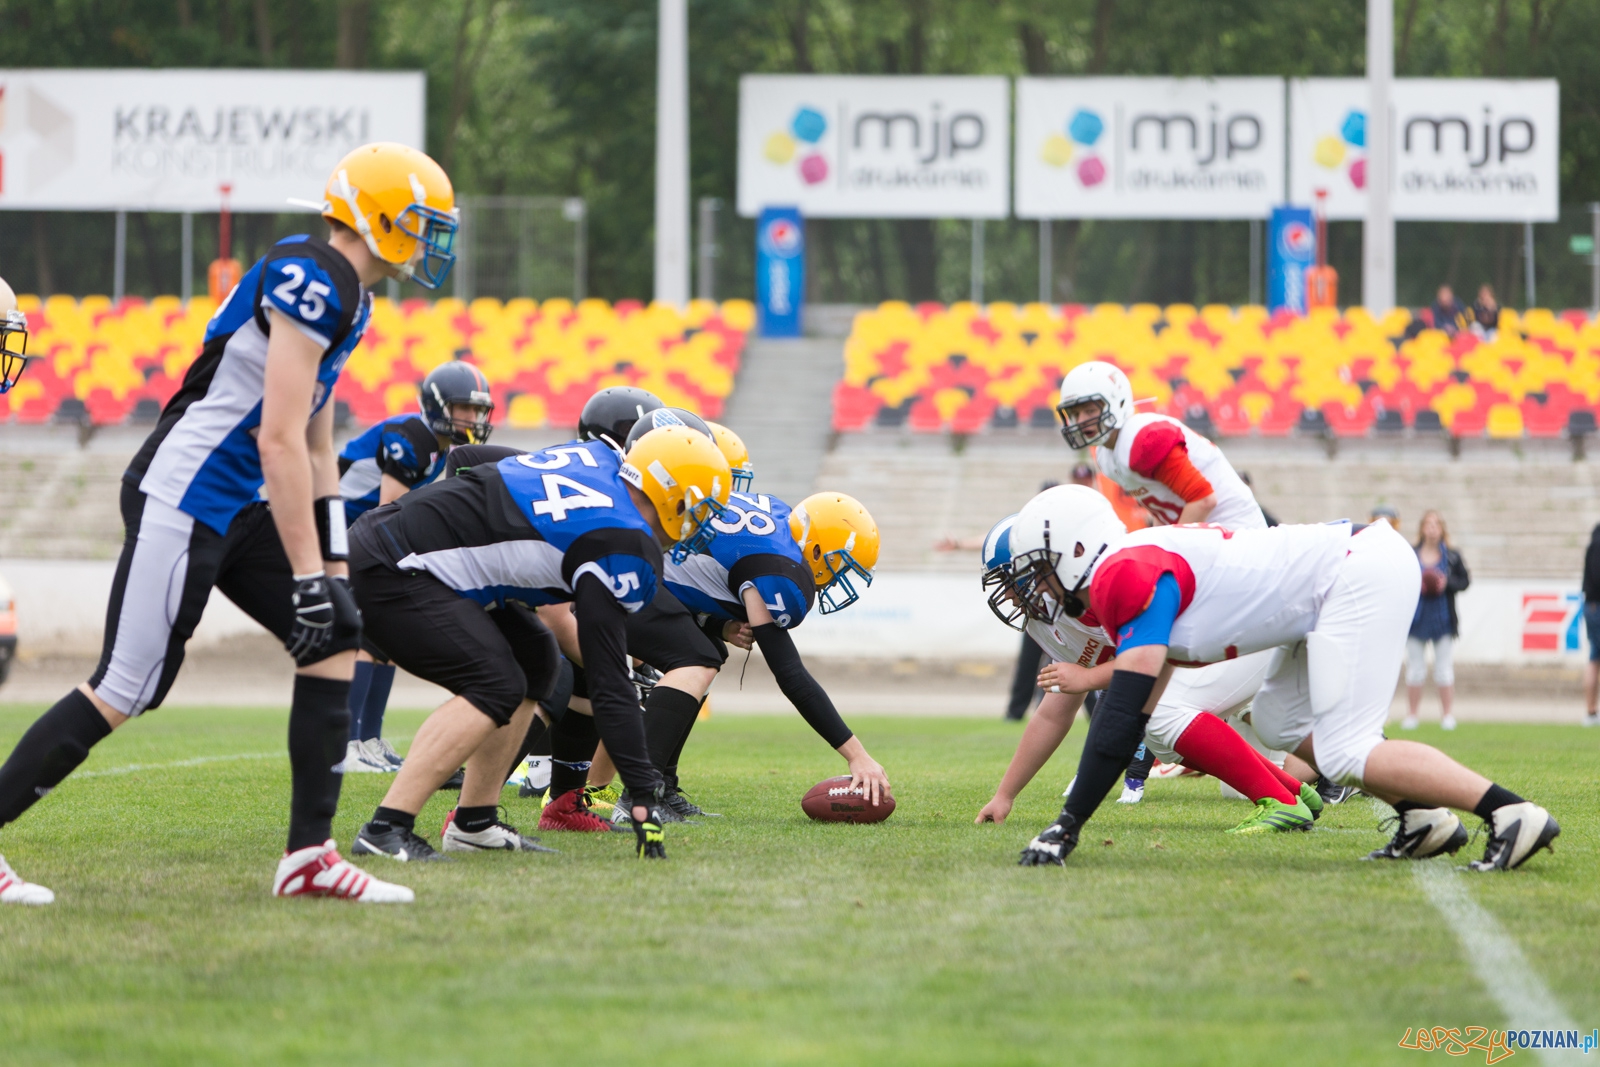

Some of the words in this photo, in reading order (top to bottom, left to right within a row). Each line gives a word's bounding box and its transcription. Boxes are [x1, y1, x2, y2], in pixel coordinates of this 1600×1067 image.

[114, 105, 370, 143] KRAJEWSKI
[854, 102, 986, 165] mjp
[1131, 102, 1263, 166] mjp
[1404, 105, 1536, 168] mjp
[112, 145, 345, 179] KONSTRUKC
[272, 263, 331, 321] 25
[515, 446, 615, 522] 54
[709, 490, 777, 536] 78
